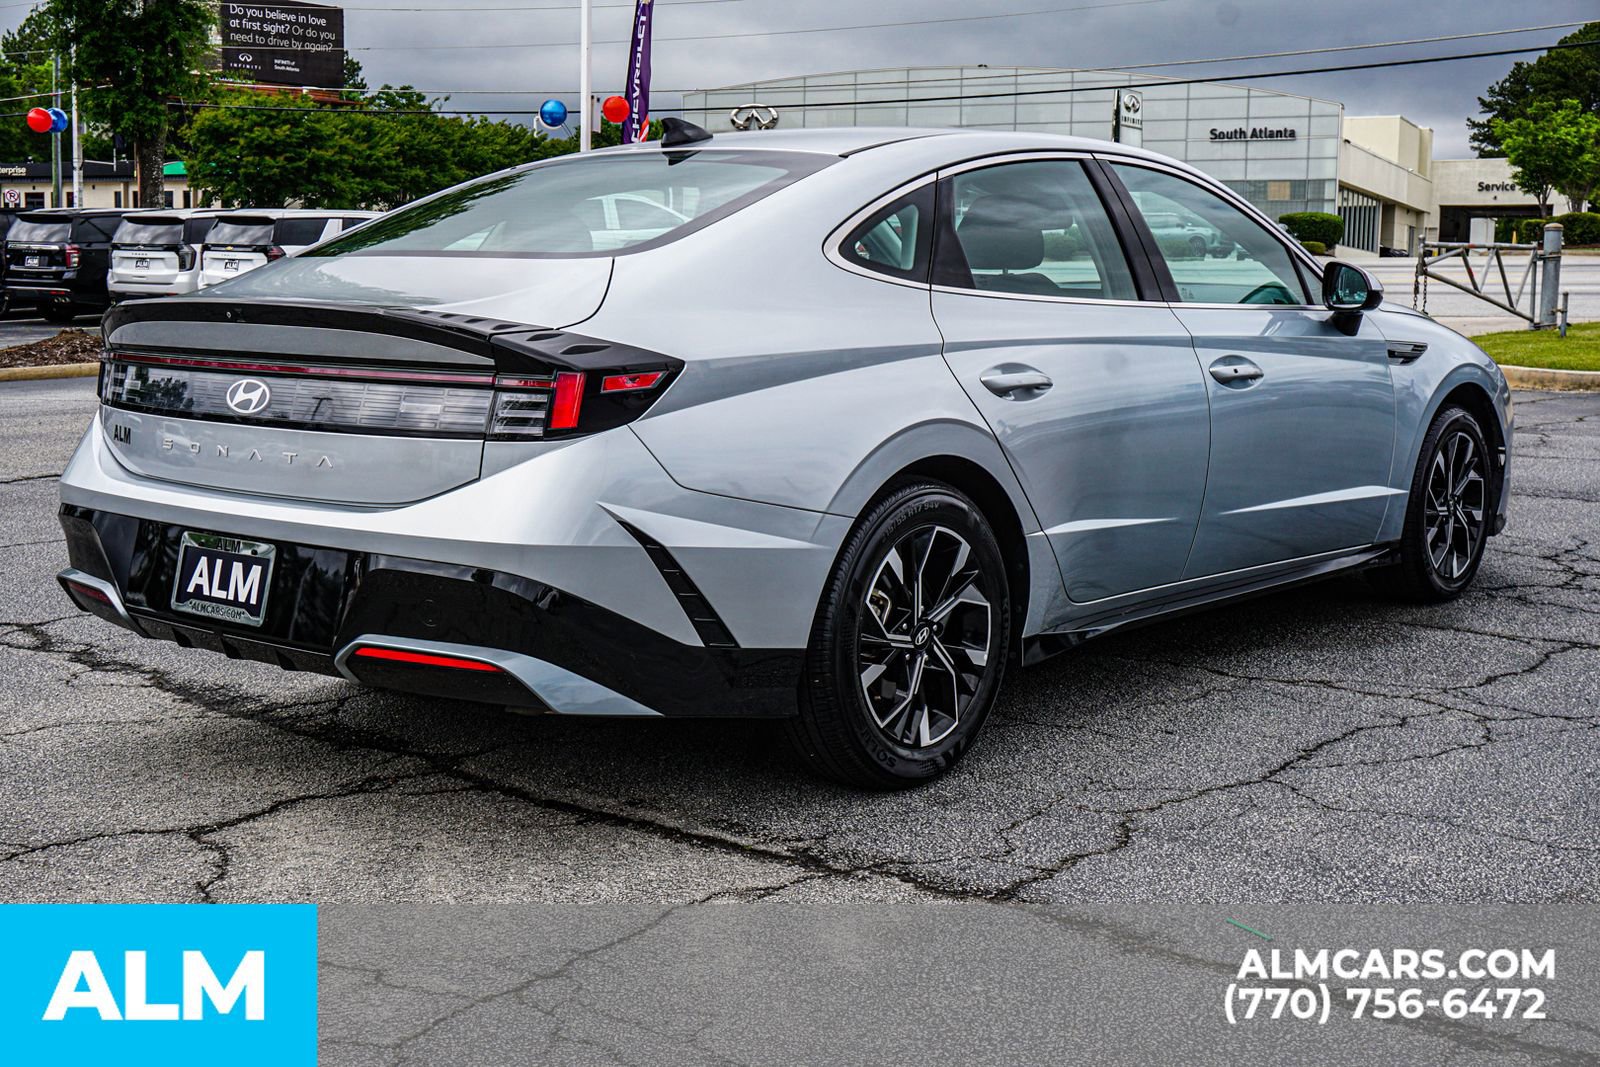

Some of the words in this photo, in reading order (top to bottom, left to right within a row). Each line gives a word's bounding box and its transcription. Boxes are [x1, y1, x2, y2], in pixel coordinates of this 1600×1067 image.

[229, 3, 244, 14] Do
[246, 9, 263, 18] you
[266, 8, 296, 22] believe
[298, 13, 306, 24] in
[308, 14, 327, 26] love
[229, 19, 240, 28] at
[242, 19, 261, 31] first
[263, 22, 290, 35] sight?
[292, 25, 304, 36] Or
[306, 27, 317, 38] do
[320, 31, 336, 41] you
[230, 32, 253, 43] need
[255, 34, 266, 44] to
[268, 36, 290, 47] drive
[291, 38, 302, 50] by
[304, 42, 333, 53] again?
[230, 62, 261, 70] INFINITI
[631, 15, 647, 143] CHEVROLET
[1209, 128, 1247, 140] South
[1250, 127, 1296, 139] Atlanta
[1478, 181, 1516, 192] Service
[113, 424, 131, 445] ALM
[162, 438, 334, 468] SONATA
[216, 538, 242, 553] ALM
[187, 556, 262, 605] ALM
